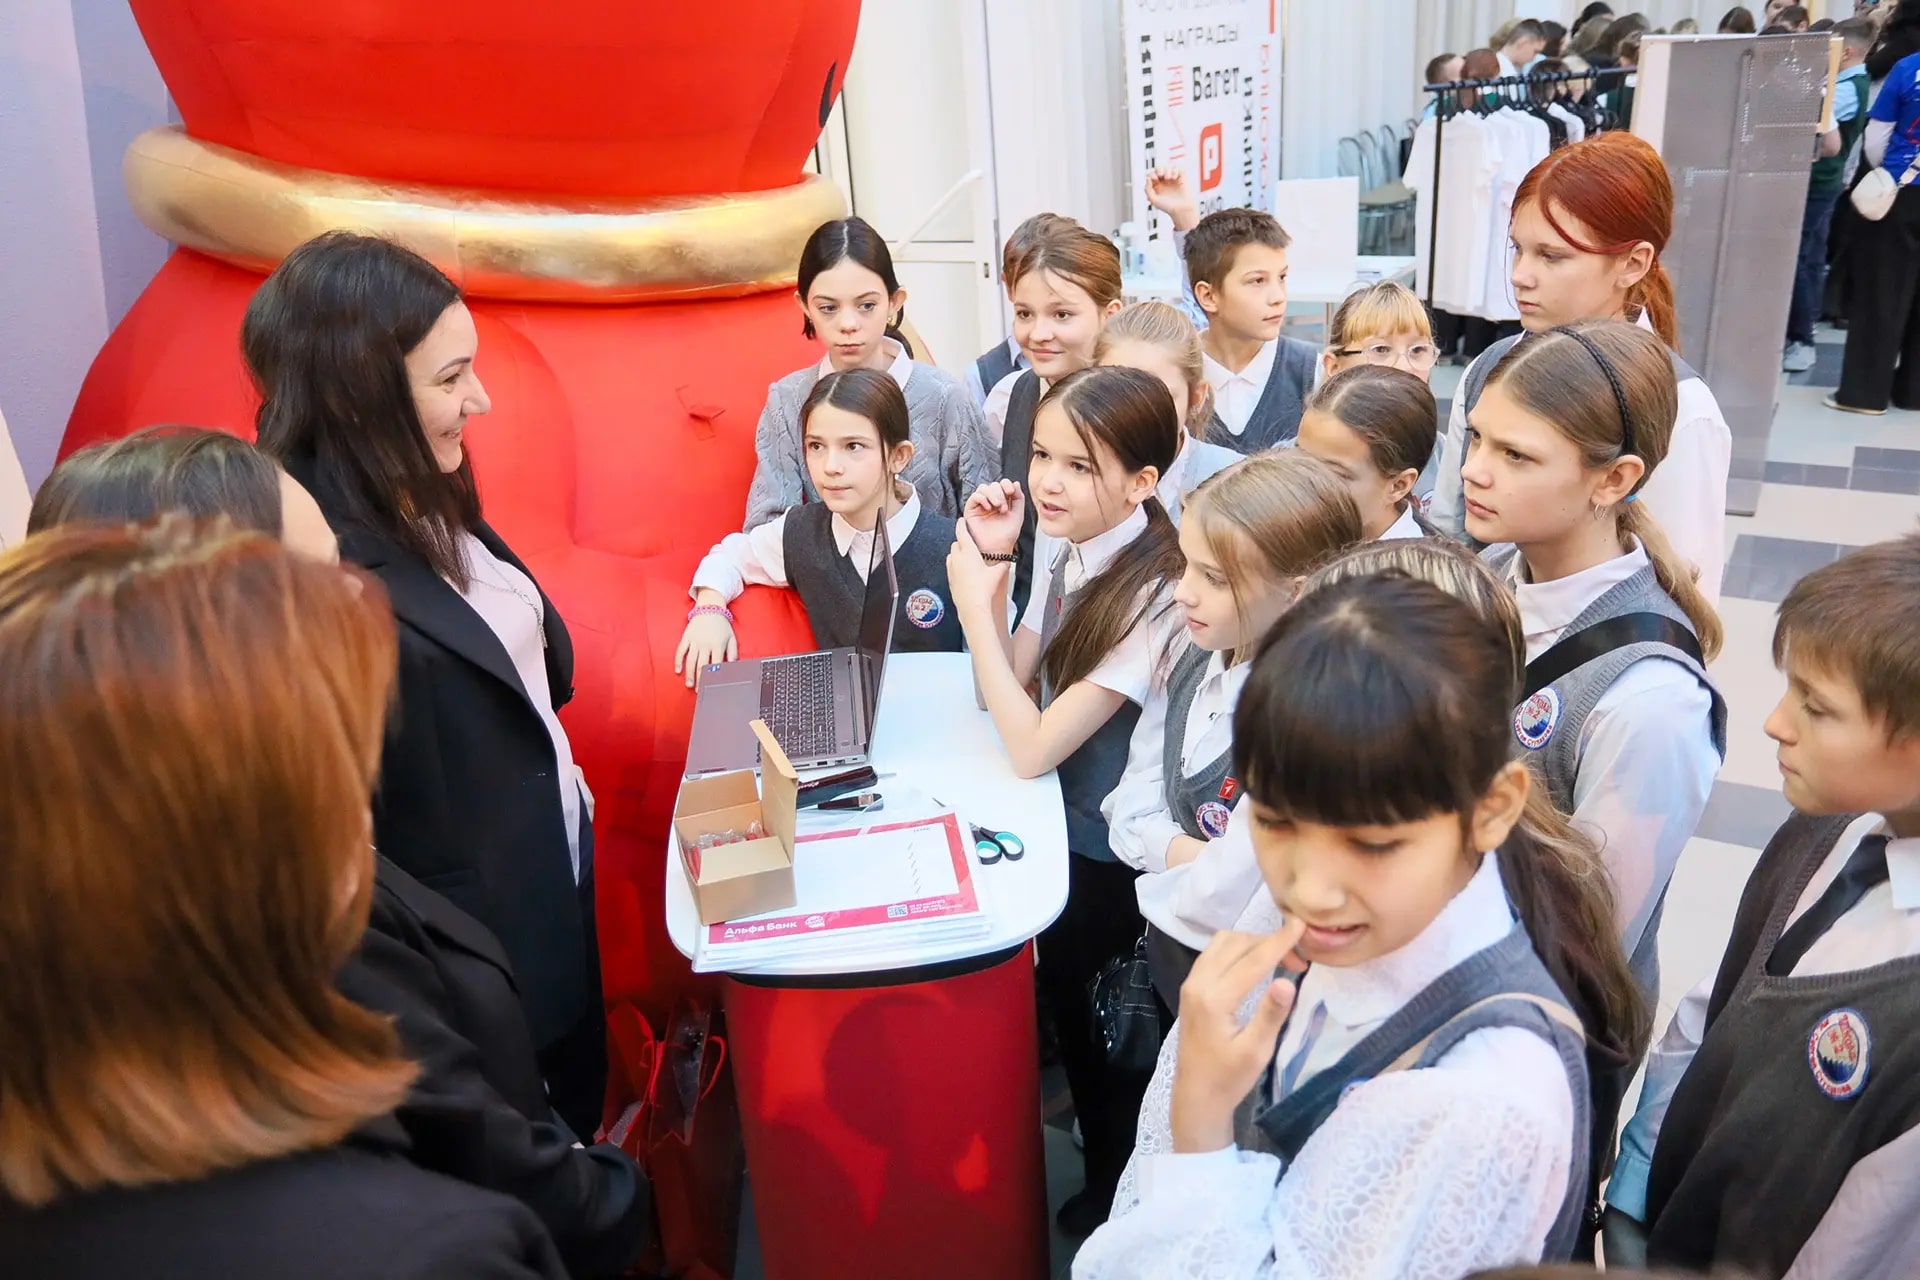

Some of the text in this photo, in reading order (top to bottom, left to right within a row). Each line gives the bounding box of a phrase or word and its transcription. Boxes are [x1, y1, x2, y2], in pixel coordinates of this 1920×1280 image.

[1164, 24, 1240, 50] НАГРАДЫ
[1192, 66, 1239, 101] Багет
[724, 924, 765, 937] Альфа
[766, 921, 798, 932] Банк
